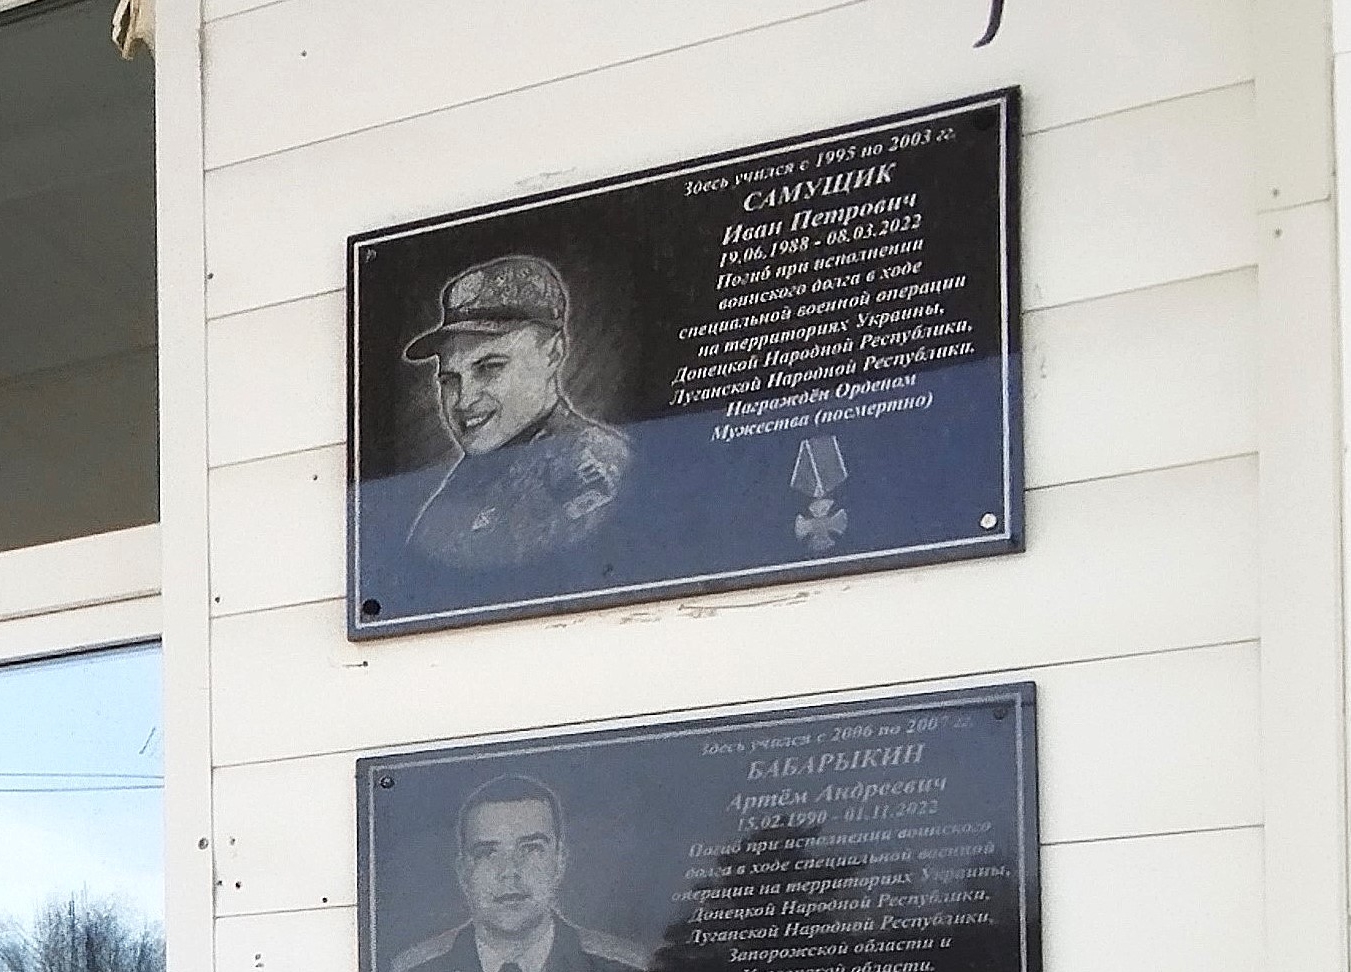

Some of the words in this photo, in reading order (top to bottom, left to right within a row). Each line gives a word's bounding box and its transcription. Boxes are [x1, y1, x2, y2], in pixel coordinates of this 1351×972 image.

[683, 177, 729, 197] Здесь
[732, 162, 794, 189] учился
[816, 148, 857, 168] 1995
[861, 143, 883, 159] по
[888, 128, 931, 152] 2003
[742, 161, 898, 212] САМУЩИК
[719, 236, 809, 268] 19.06.1988
[826, 213, 923, 247] 08.03.2022
[722, 220, 783, 246] Иван
[791, 191, 917, 233] Петрович
[715, 264, 771, 290] Погиб
[774, 259, 809, 280] при
[814, 236, 924, 271] исполнении
[718, 282, 807, 311] воинского
[812, 273, 861, 295] долга
[865, 270, 876, 283] в
[879, 258, 923, 281] ходе
[677, 305, 791, 340] специальной
[796, 291, 871, 318] военной
[875, 273, 967, 303] операции
[697, 341, 720, 357] на
[723, 318, 850, 353] территориях
[856, 303, 945, 329] Украины,
[669, 376, 761, 406] Луганской
[767, 358, 857, 389] Народной
[670, 354, 759, 386] Донецкой
[762, 337, 854, 368] Народной
[711, 414, 810, 442] Мужества
[814, 392, 935, 426] (посмертно)
[726, 388, 831, 417] Награждён
[835, 373, 917, 399] Орденом
[746, 743, 927, 782] БАБАРЫКИН
[725, 786, 809, 815] Артём
[815, 776, 948, 803] Андреевич
[746, 837, 781, 856] при
[784, 827, 892, 851] исполнении
[749, 859, 790, 876] ходе
[794, 847, 912, 872] специальной
[671, 883, 754, 904] операции
[759, 881, 781, 896] на
[785, 873, 913, 896] территориях
[688, 903, 775, 924] Донецкой
[780, 897, 871, 917] Народной
[685, 926, 779, 947] Луганской
[782, 918, 875, 939] Народной
[728, 941, 848, 964] Запорожской
[853, 938, 933, 955] области
[939, 936, 953, 949] и
